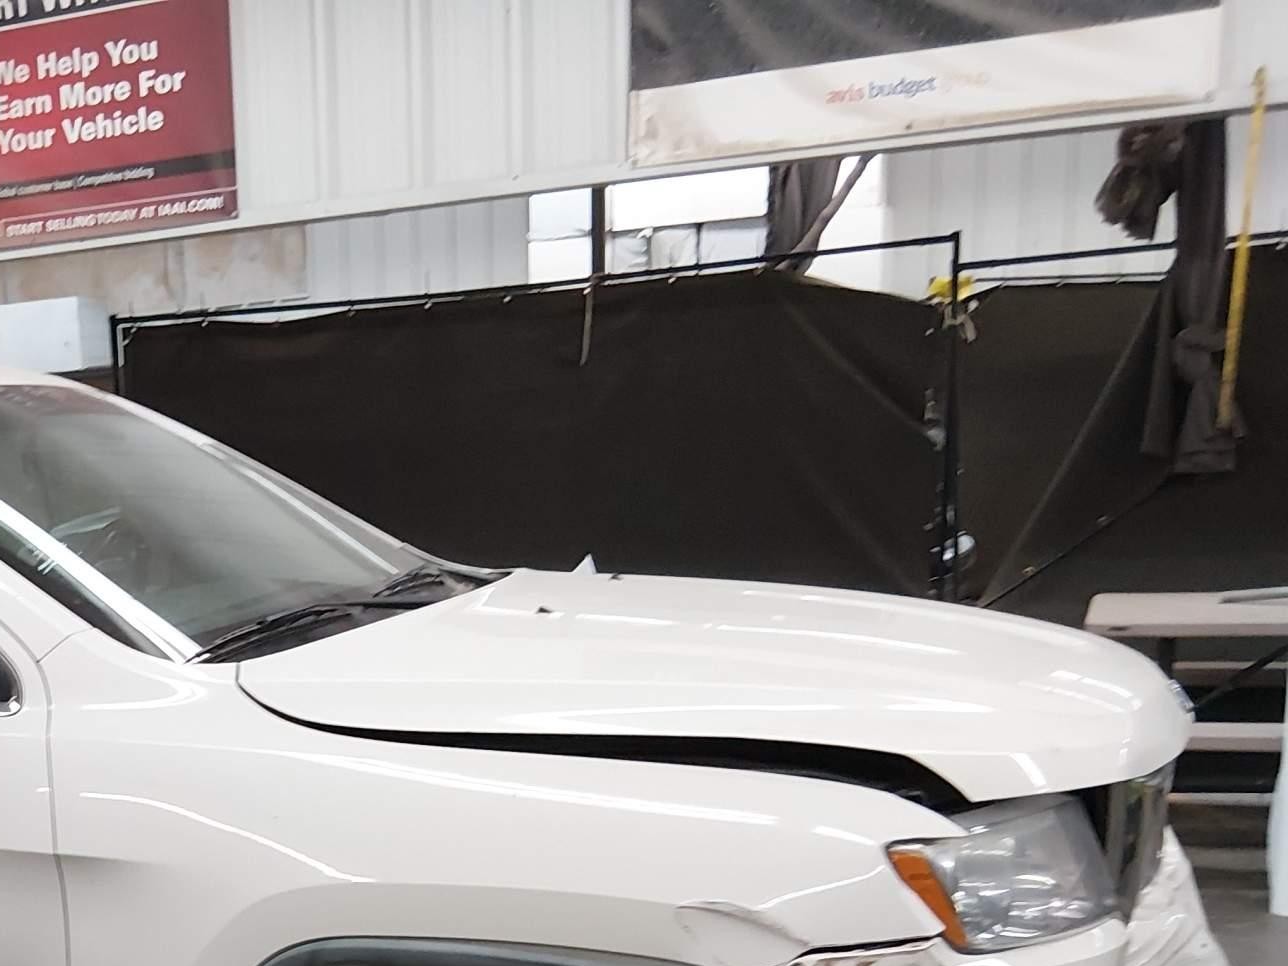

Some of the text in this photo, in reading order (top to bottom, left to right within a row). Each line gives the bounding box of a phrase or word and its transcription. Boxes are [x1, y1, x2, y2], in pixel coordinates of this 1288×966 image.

[37, 47, 100, 79] Help
[104, 38, 158, 66] You
[59, 80, 131, 111] More
[138, 67, 187, 94] For
[824, 83, 865, 105] avis
[868, 76, 937, 99] budget
[61, 106, 164, 145] Vehicle
[5, 220, 44, 238] START
[45, 215, 97, 232] SELLING
[96, 208, 139, 225] TODAY
[139, 204, 157, 219] AT
